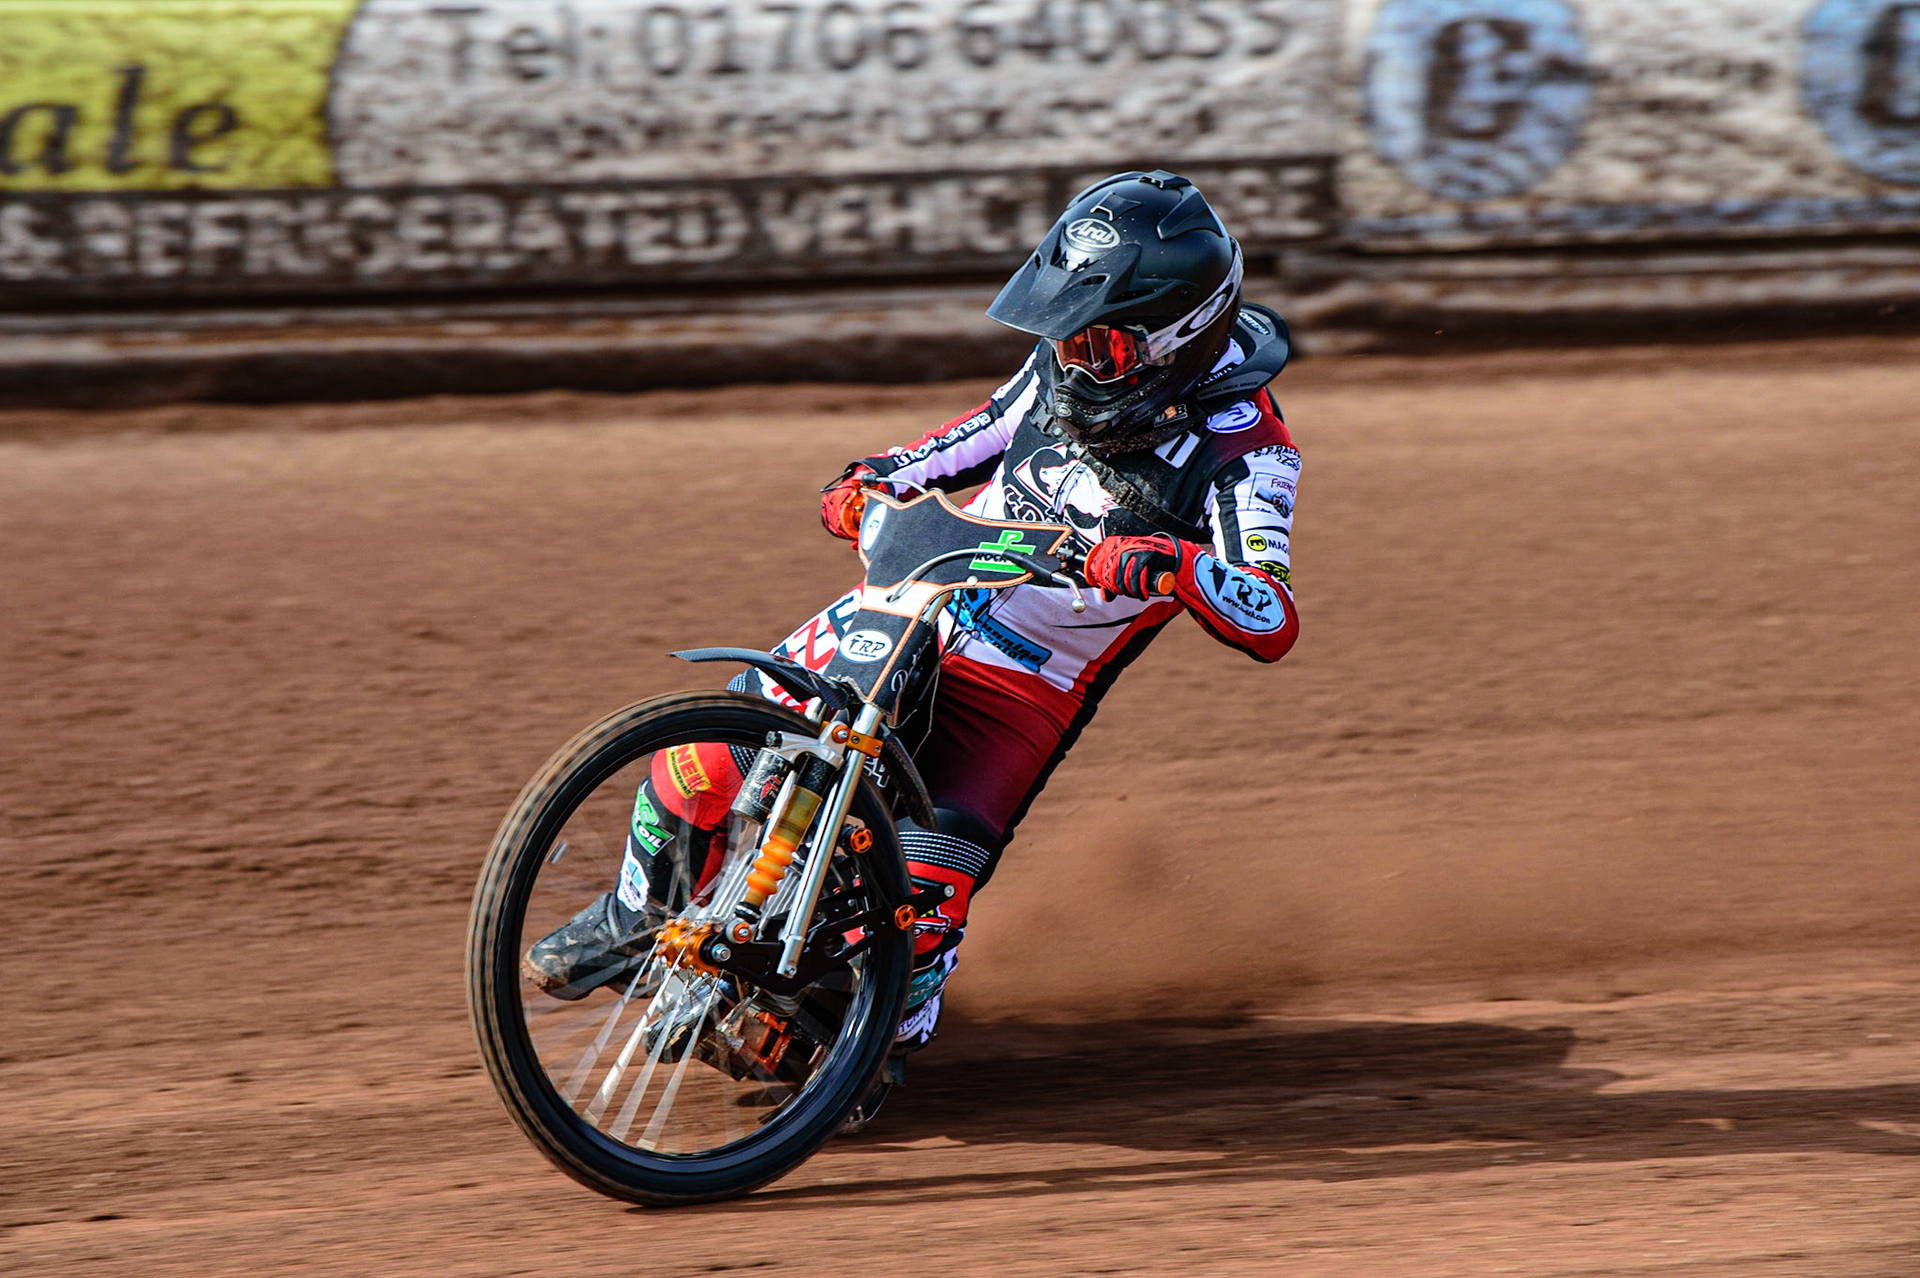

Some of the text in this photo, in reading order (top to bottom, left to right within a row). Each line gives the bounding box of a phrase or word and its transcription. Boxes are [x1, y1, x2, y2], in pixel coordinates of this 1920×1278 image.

[75, 193, 745, 276] REFRIGERATED
[1070, 220, 1115, 244] Arai
[638, 824, 663, 849] OIL
